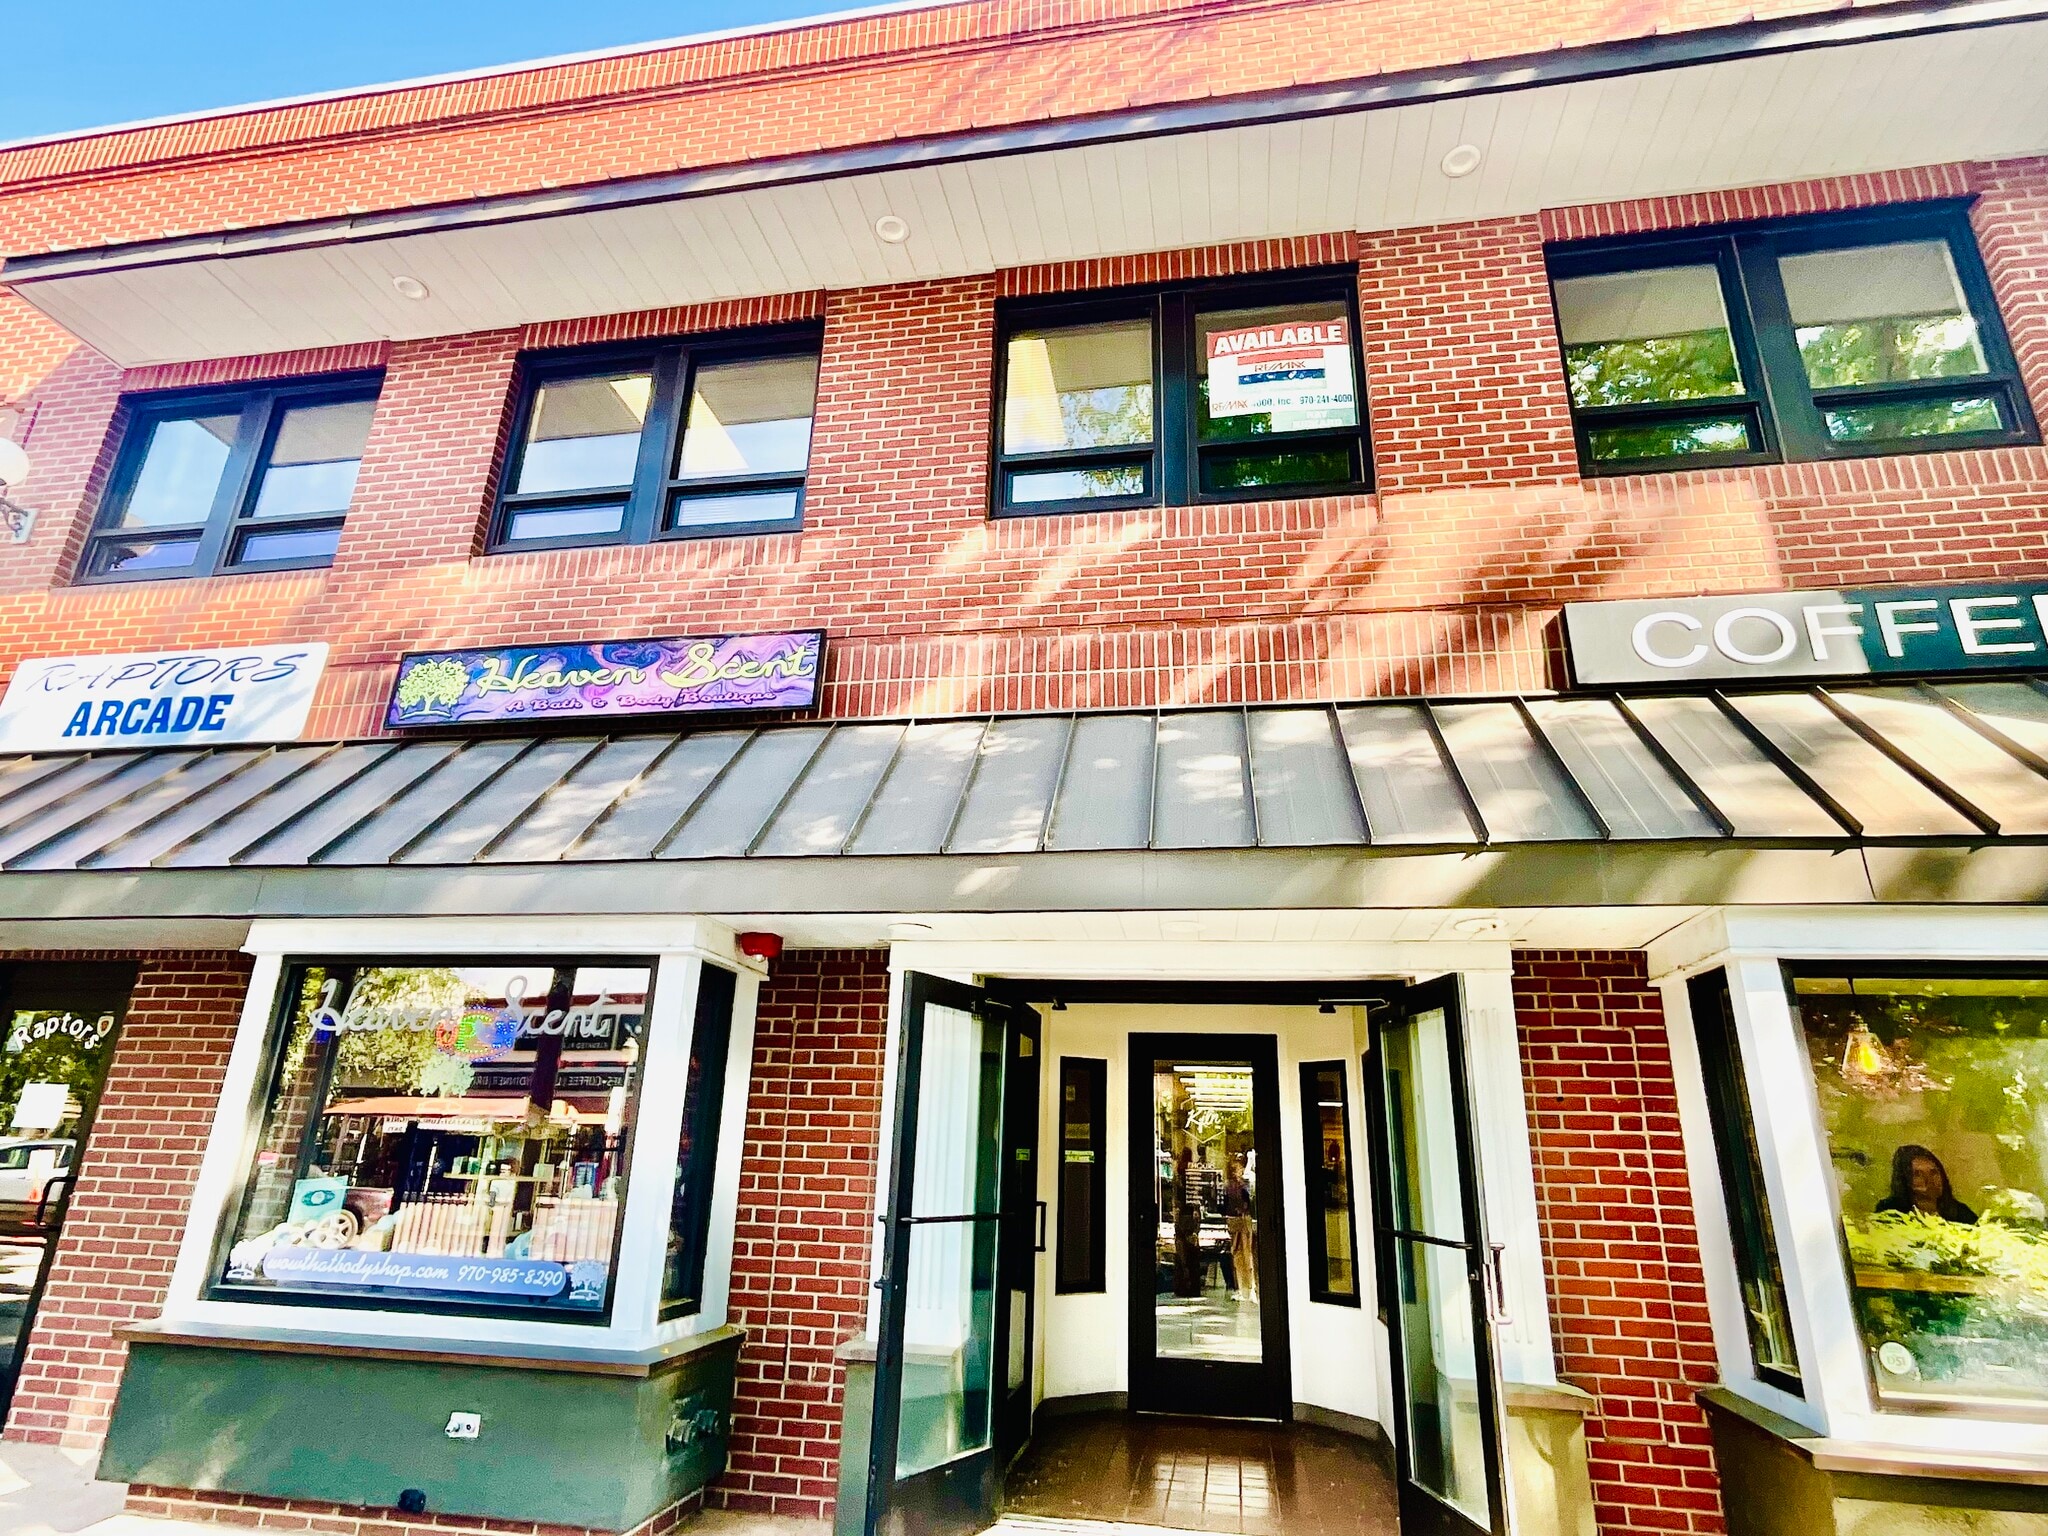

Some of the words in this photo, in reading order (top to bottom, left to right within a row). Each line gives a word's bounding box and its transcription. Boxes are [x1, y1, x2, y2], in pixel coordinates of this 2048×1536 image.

[1213, 325, 1343, 355] AVAILABLE
[1254, 360, 1306, 372] RE/MAX
[26, 653, 308, 692] RAPTORS
[478, 655, 647, 696] Heaven
[662, 643, 816, 688] Scent
[62, 694, 234, 737] ARCADE
[506, 699, 525, 711] A
[531, 697, 582, 711] Bath
[617, 694, 674, 710] Body
[679, 690, 777, 706] Boutique
[309, 977, 453, 1042] Heaven
[474, 975, 615, 1046] Scent
[13, 1012, 100, 1051] Raptors
[457, 1264, 562, 1287] 970-985-8290
